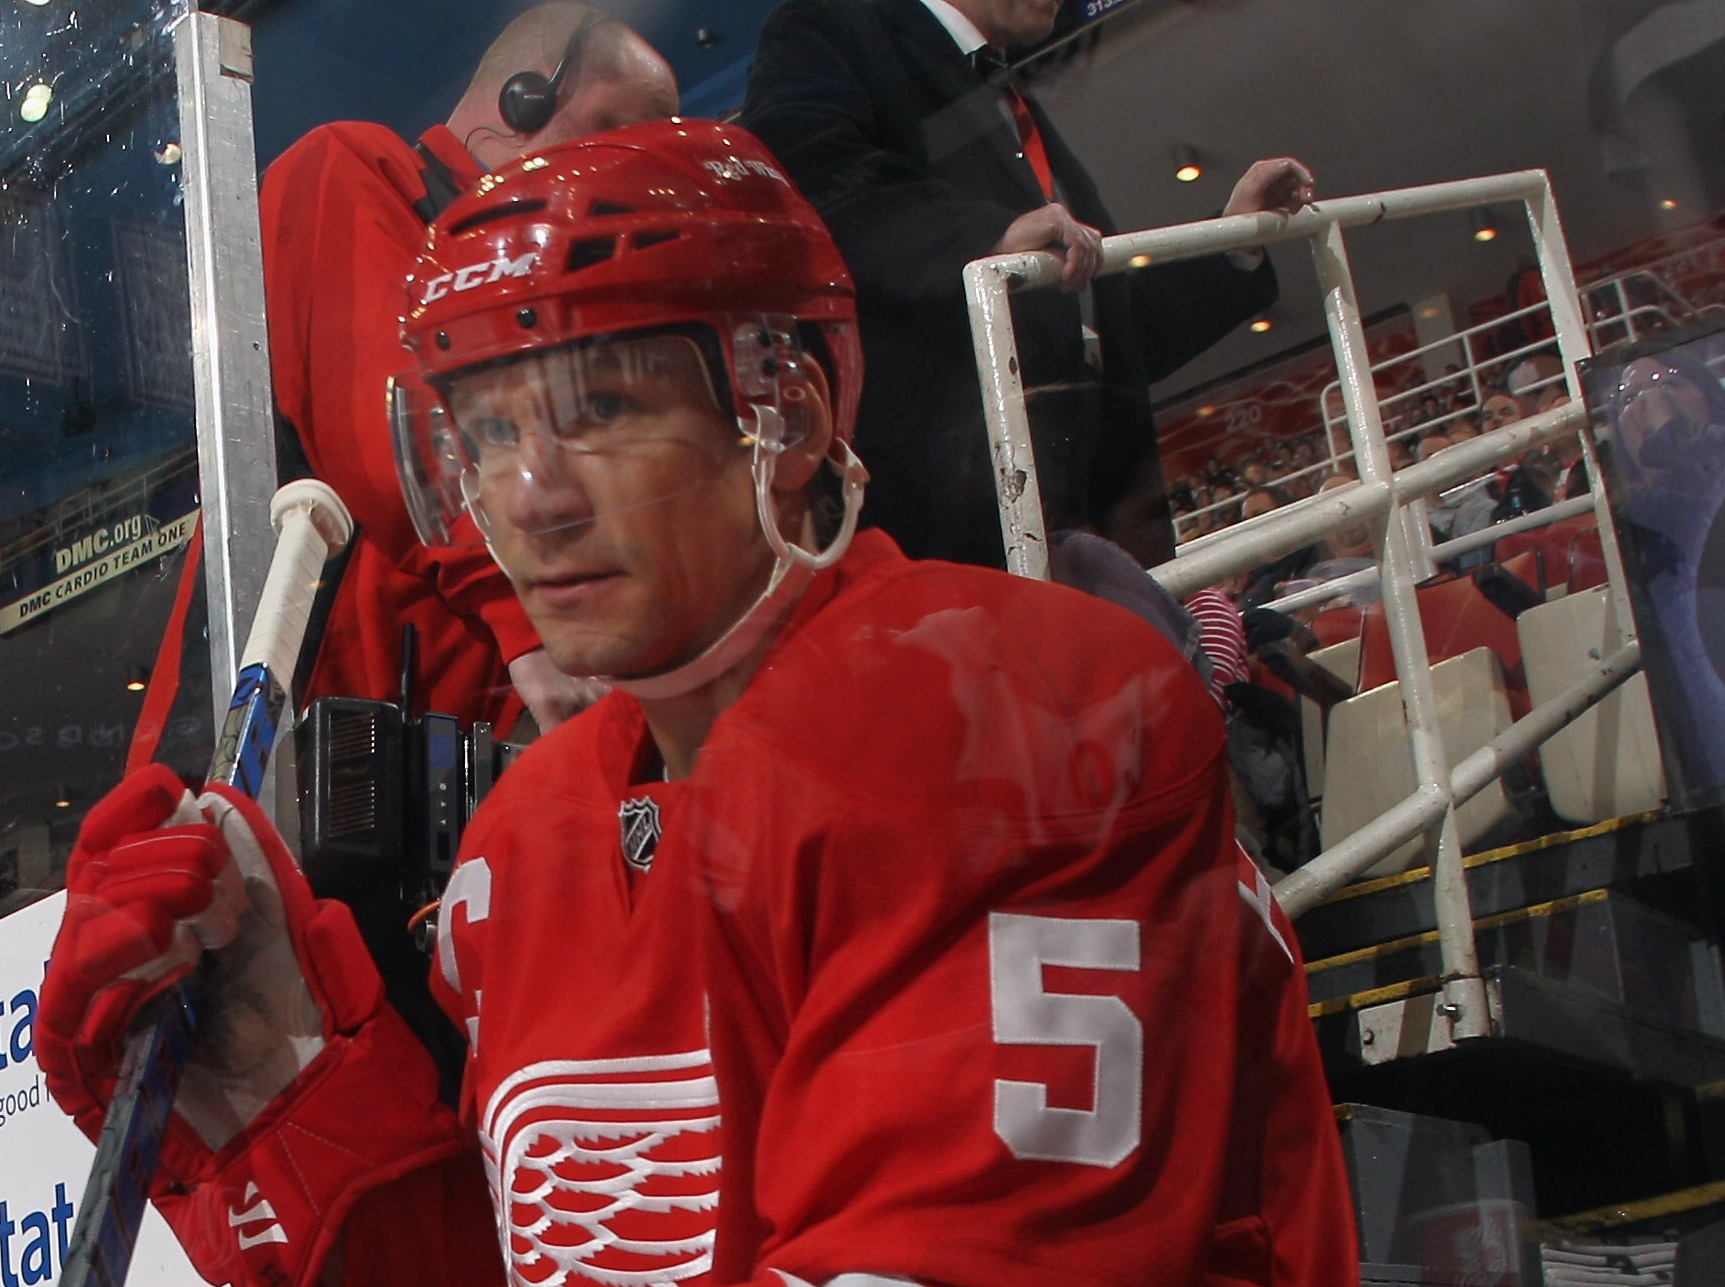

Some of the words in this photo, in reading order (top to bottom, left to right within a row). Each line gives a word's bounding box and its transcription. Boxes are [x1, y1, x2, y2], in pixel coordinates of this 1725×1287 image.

[424, 252, 538, 302] CCM
[19, 591, 52, 618] DMC
[55, 562, 109, 599] CARDIO
[113, 540, 153, 571] TEAM
[157, 521, 187, 548] ONE
[55, 514, 141, 575] DMC.org
[988, 912, 1143, 1169] 5
